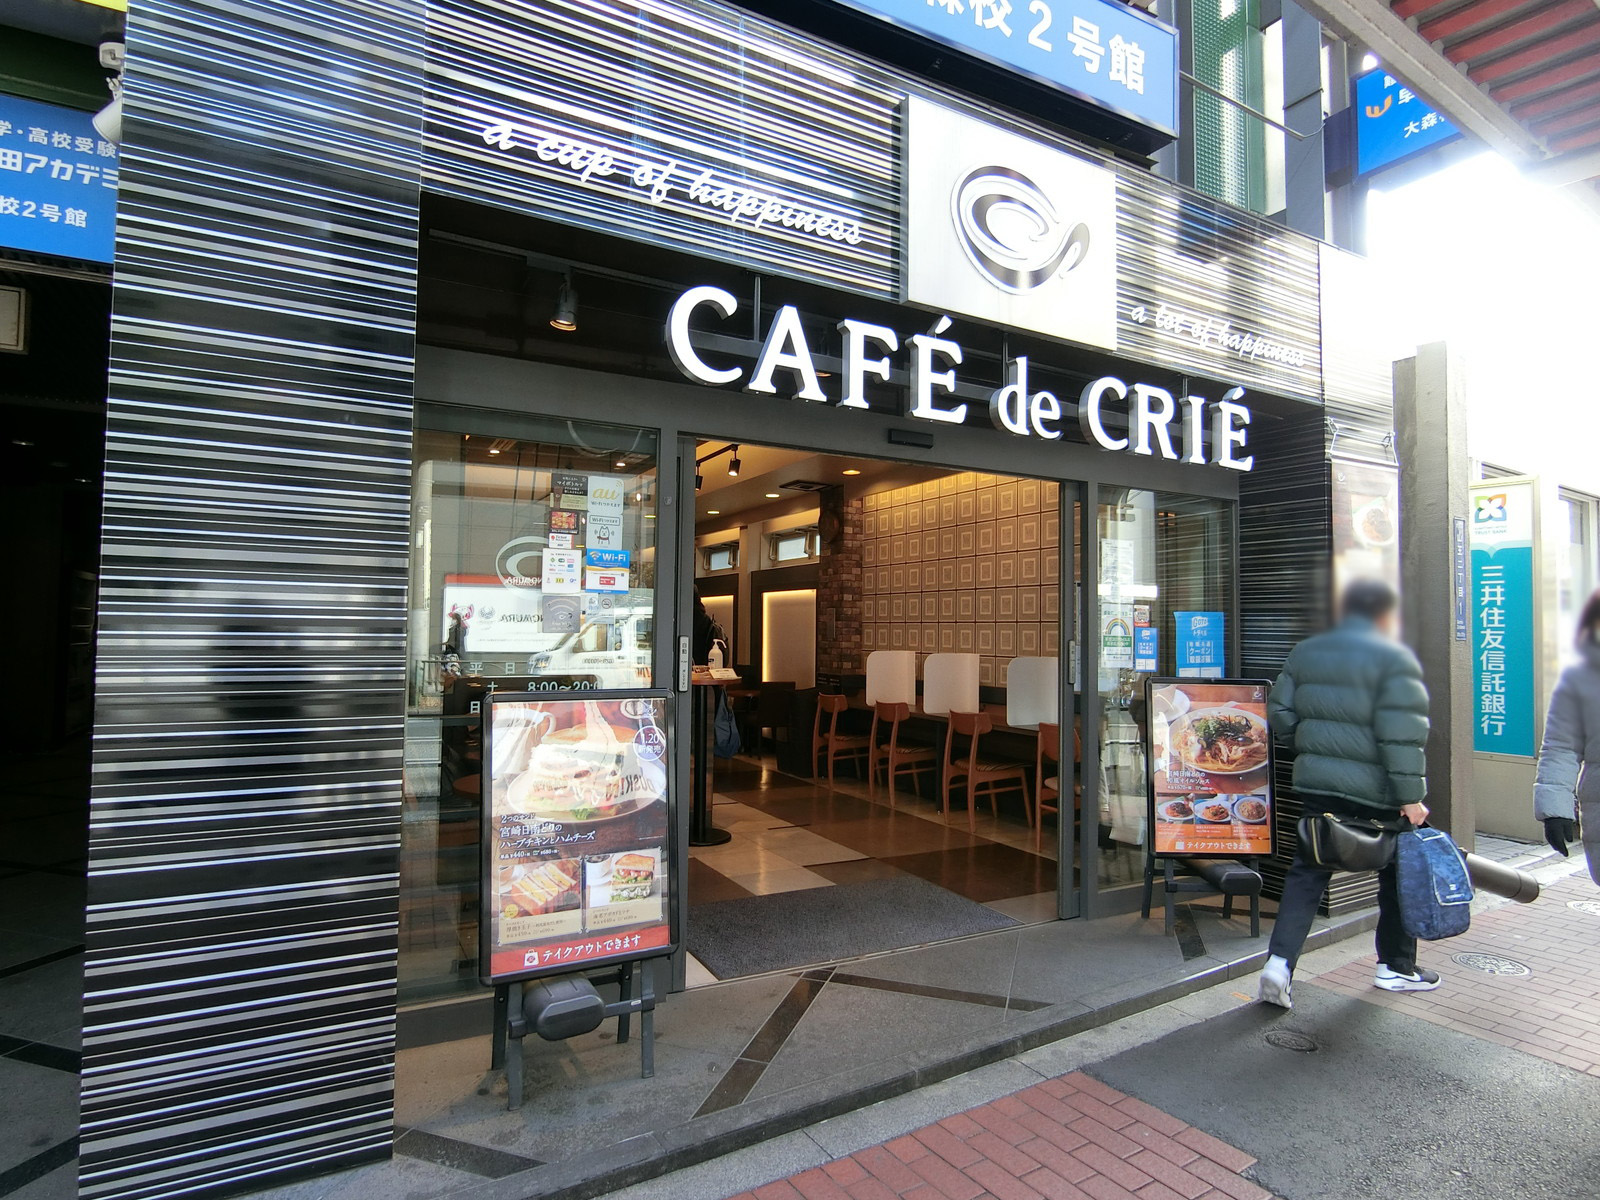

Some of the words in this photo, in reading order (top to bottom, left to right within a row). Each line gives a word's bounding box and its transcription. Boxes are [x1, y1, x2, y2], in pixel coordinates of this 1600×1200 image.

[926, 0, 1145, 95] 校2号館
[1403, 112, 1445, 138] 大森
[482, 120, 518, 150] a
[536, 136, 617, 182] cup
[633, 158, 676, 203] of
[688, 168, 863, 244] happiness
[667, 285, 968, 424] CAFÉ
[990, 356, 1063, 441] de
[1079, 376, 1254, 472] CRIÉ
[592, 488, 618, 500] au
[602, 553, 626, 562] Wi-Fi
[1479, 564, 1507, 737] 三井住友信託銀行
[543, 934, 641, 962] テイクアウトできます
